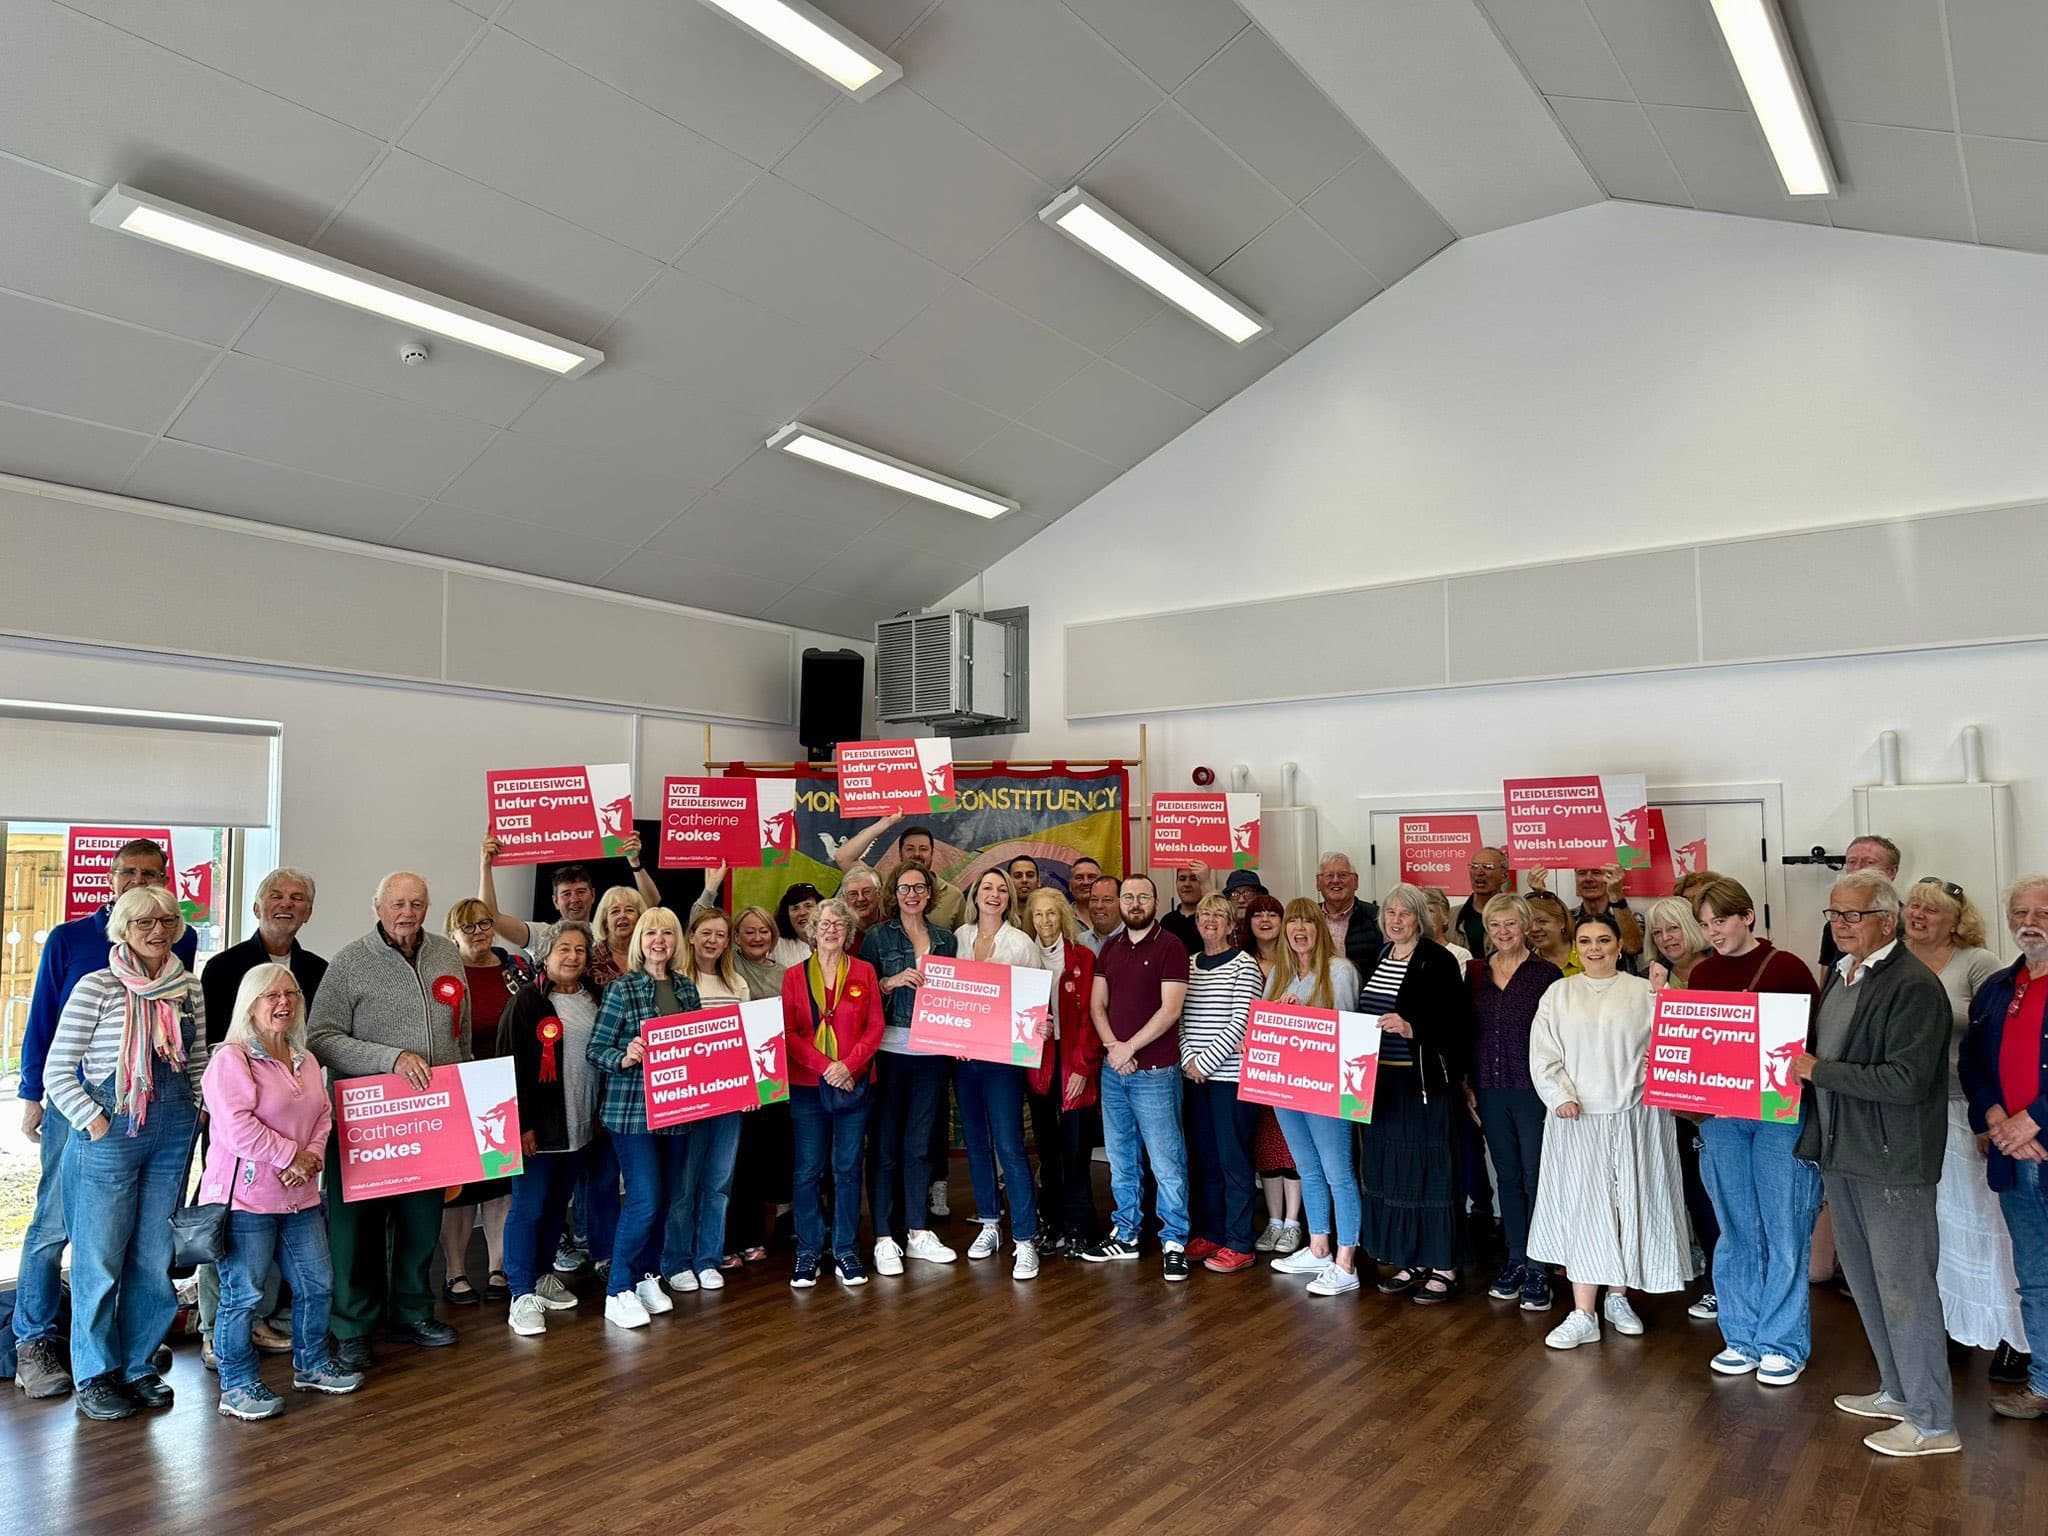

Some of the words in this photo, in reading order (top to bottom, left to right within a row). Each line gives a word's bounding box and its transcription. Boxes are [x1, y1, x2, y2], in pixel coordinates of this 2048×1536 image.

[844, 749, 912, 758] PLEIDLEISIWCH
[843, 763, 875, 773] Llafur
[878, 761, 917, 774] Cymru
[497, 779, 582, 792] PLEIDLEISIWCH
[846, 779, 870, 787] VOTE
[671, 786, 698, 794] VOTE
[844, 790, 880, 801] Welsh
[882, 789, 922, 799] Labour
[1513, 788, 1596, 799] PLEIDLEISIWCH
[495, 797, 536, 810] Llafur
[539, 795, 588, 810] Cymru
[671, 798, 744, 807] PLEIDLEISIWCH
[1158, 802, 1222, 810] PLEIDLEISIWCH
[1511, 805, 1550, 816] Llafur
[1553, 804, 1602, 818] Cymru
[499, 817, 529, 827] VOTE
[668, 813, 739, 826] Catherine
[1155, 814, 1186, 824] Llafur
[1187, 815, 1226, 827] Cymru
[667, 829, 720, 841] Fookes
[1514, 824, 1544, 833] VOTE
[497, 832, 542, 845] Welsh
[545, 829, 594, 842] Labour
[1406, 834, 1469, 842] PLEIDLEISIWCH
[1154, 842, 1187, 852] Welsh
[1189, 843, 1228, 853] Labour
[1513, 838, 1556, 850] Welsh
[1558, 838, 1608, 849] Labour
[1405, 847, 1466, 858] Catherine
[1405, 861, 1451, 872] Fookes
[76, 876, 107, 885] VOTE
[927, 965, 953, 975] VOTE
[926, 979, 997, 995] PLEIDLEISIWCH
[921, 993, 991, 1014] Catherine
[1663, 1004, 1752, 1019] PLEIDLEISIWCH
[918, 1010, 972, 1028] Fookes
[1256, 1014, 1333, 1033] PLEIDLEISIWCH
[651, 1019, 736, 1043] PLEIDLEISIWCH
[1658, 1023, 1700, 1039] Llafur
[1701, 1027, 1755, 1045] Cymru
[1251, 1029, 1288, 1046] Llafur
[1289, 1035, 1335, 1053] Cymru
[649, 1045, 691, 1064] Llafur
[693, 1037, 743, 1057] Cymru
[1251, 1050, 1278, 1063] VOTE
[1658, 1048, 1688, 1061] VOTE
[653, 1068, 684, 1083] VOTE
[1246, 1067, 1285, 1085] Welsh
[1287, 1073, 1335, 1093] Labour
[1652, 1067, 1697, 1084] Welsh
[1699, 1070, 1754, 1090] Labour
[345, 1088, 381, 1101] VOTE
[652, 1084, 698, 1104] Welsh
[700, 1075, 749, 1094] Labour
[347, 1095, 446, 1118] PLEIDLEISIWCH
[347, 1117, 443, 1143] Catherine
[349, 1140, 422, 1164] Fookes
